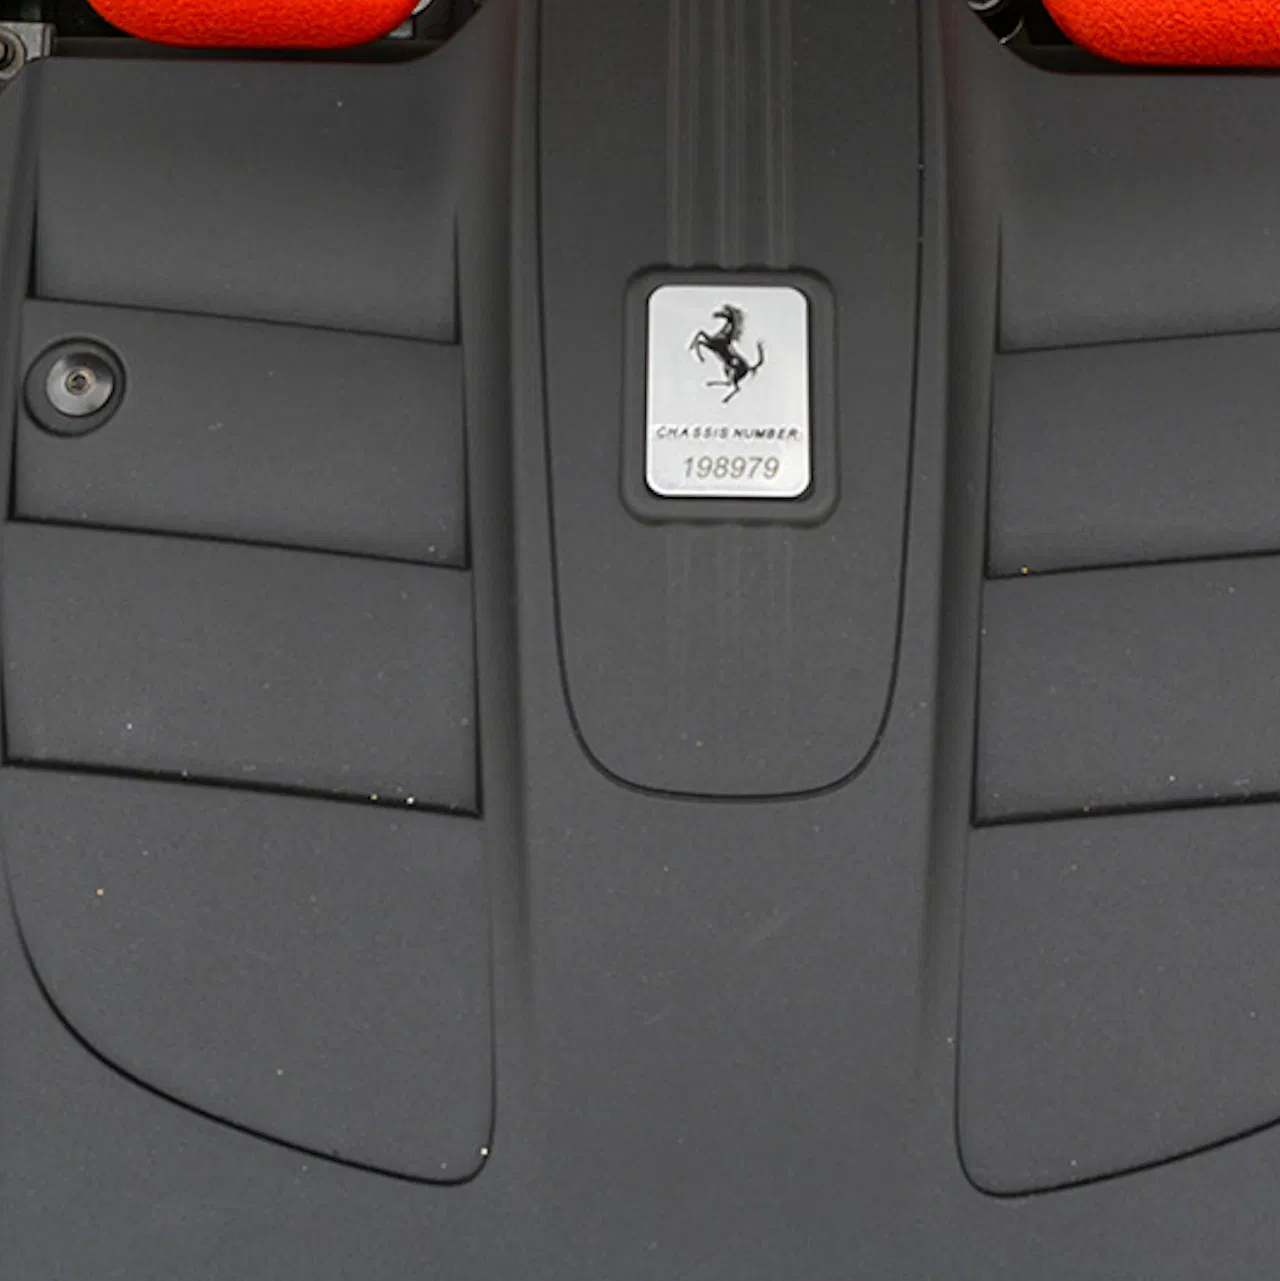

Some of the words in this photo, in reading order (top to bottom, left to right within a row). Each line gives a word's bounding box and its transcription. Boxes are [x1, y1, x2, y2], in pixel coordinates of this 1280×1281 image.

[656, 426, 730, 440] CHASSIS
[733, 428, 801, 440] NUMBER
[683, 455, 781, 480] 198979
